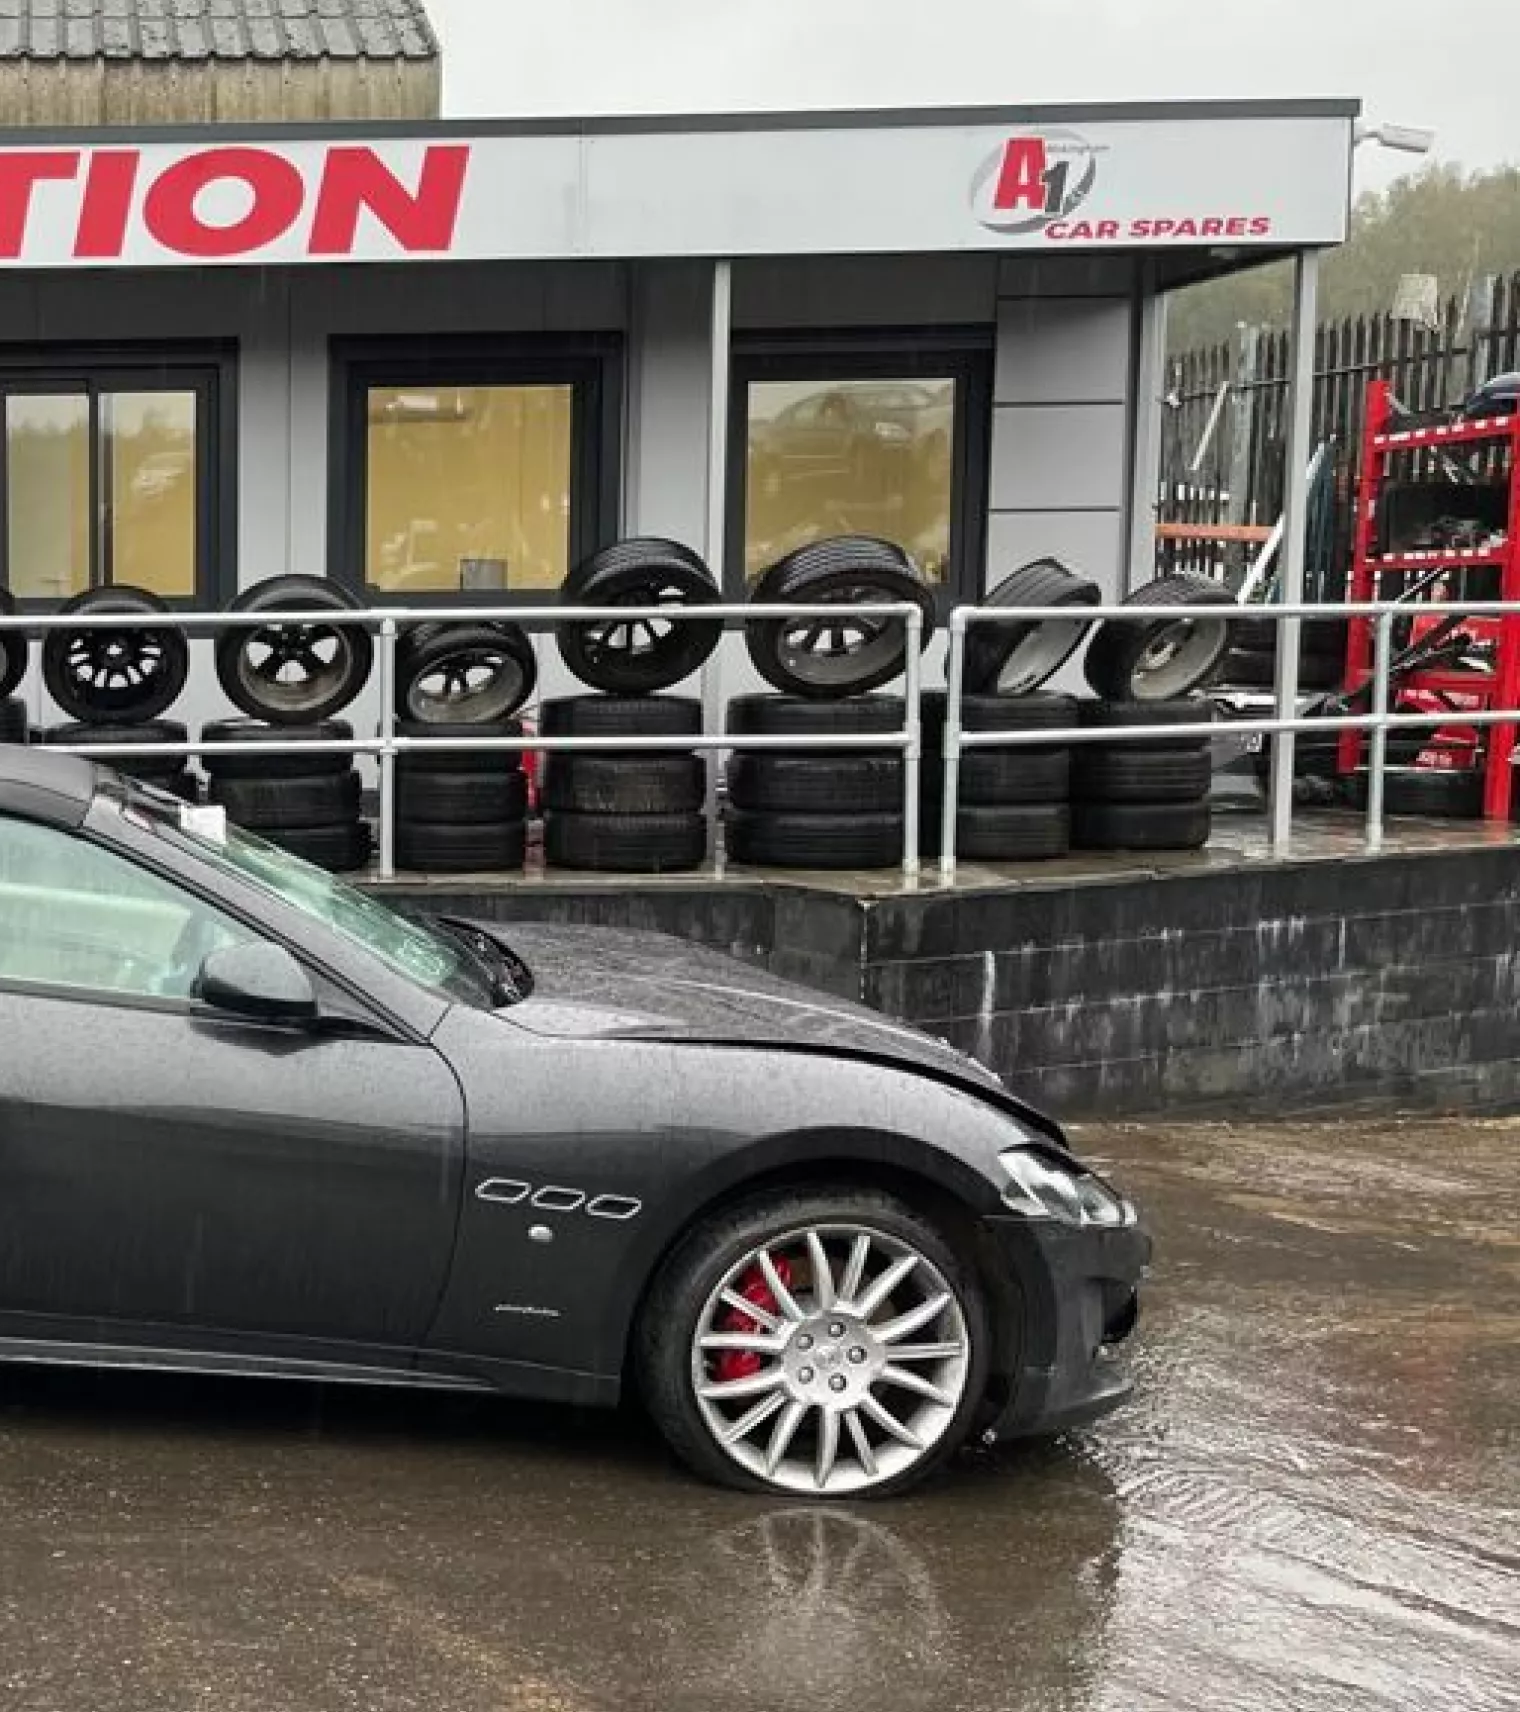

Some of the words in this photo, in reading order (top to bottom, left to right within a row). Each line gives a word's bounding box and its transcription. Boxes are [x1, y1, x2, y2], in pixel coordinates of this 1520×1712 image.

[994, 138, 1070, 212] A1
[1044, 220, 1120, 239] CAR
[1128, 217, 1271, 237] SPARES
